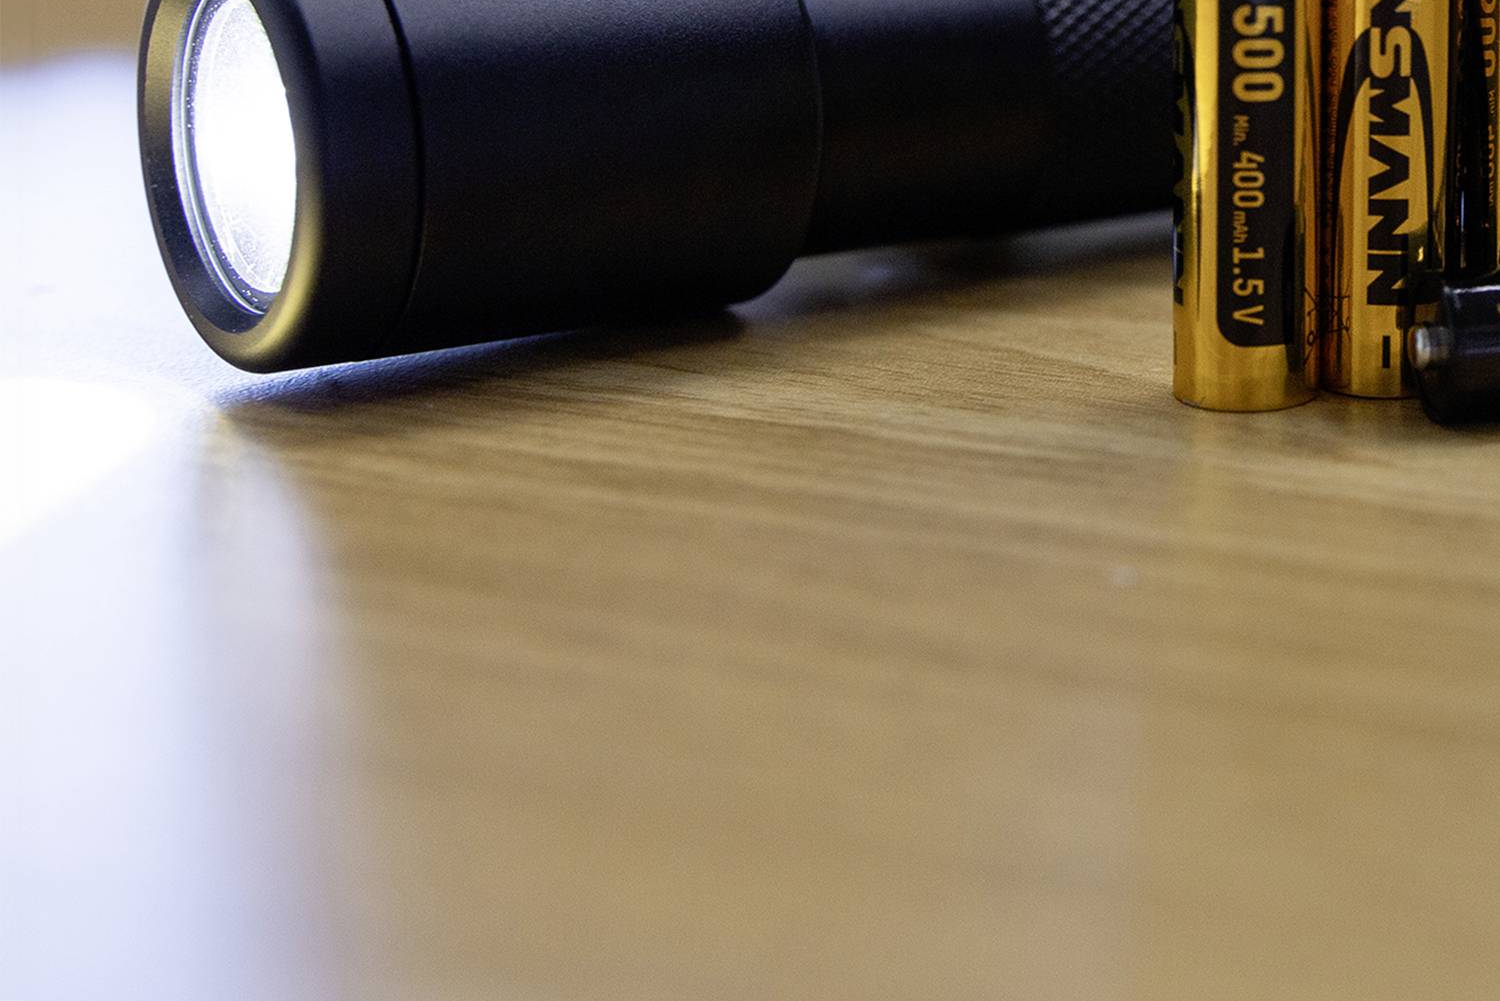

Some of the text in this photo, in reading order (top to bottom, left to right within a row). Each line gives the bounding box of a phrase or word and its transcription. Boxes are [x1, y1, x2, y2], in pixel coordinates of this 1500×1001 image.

[1232, 4, 1285, 102] 500
[1232, 114, 1251, 147] Min.
[1232, 151, 1265, 208] 400
[1232, 210, 1250, 243] mAh
[1232, 247, 1264, 297] 1.5
[1232, 304, 1264, 326] V
